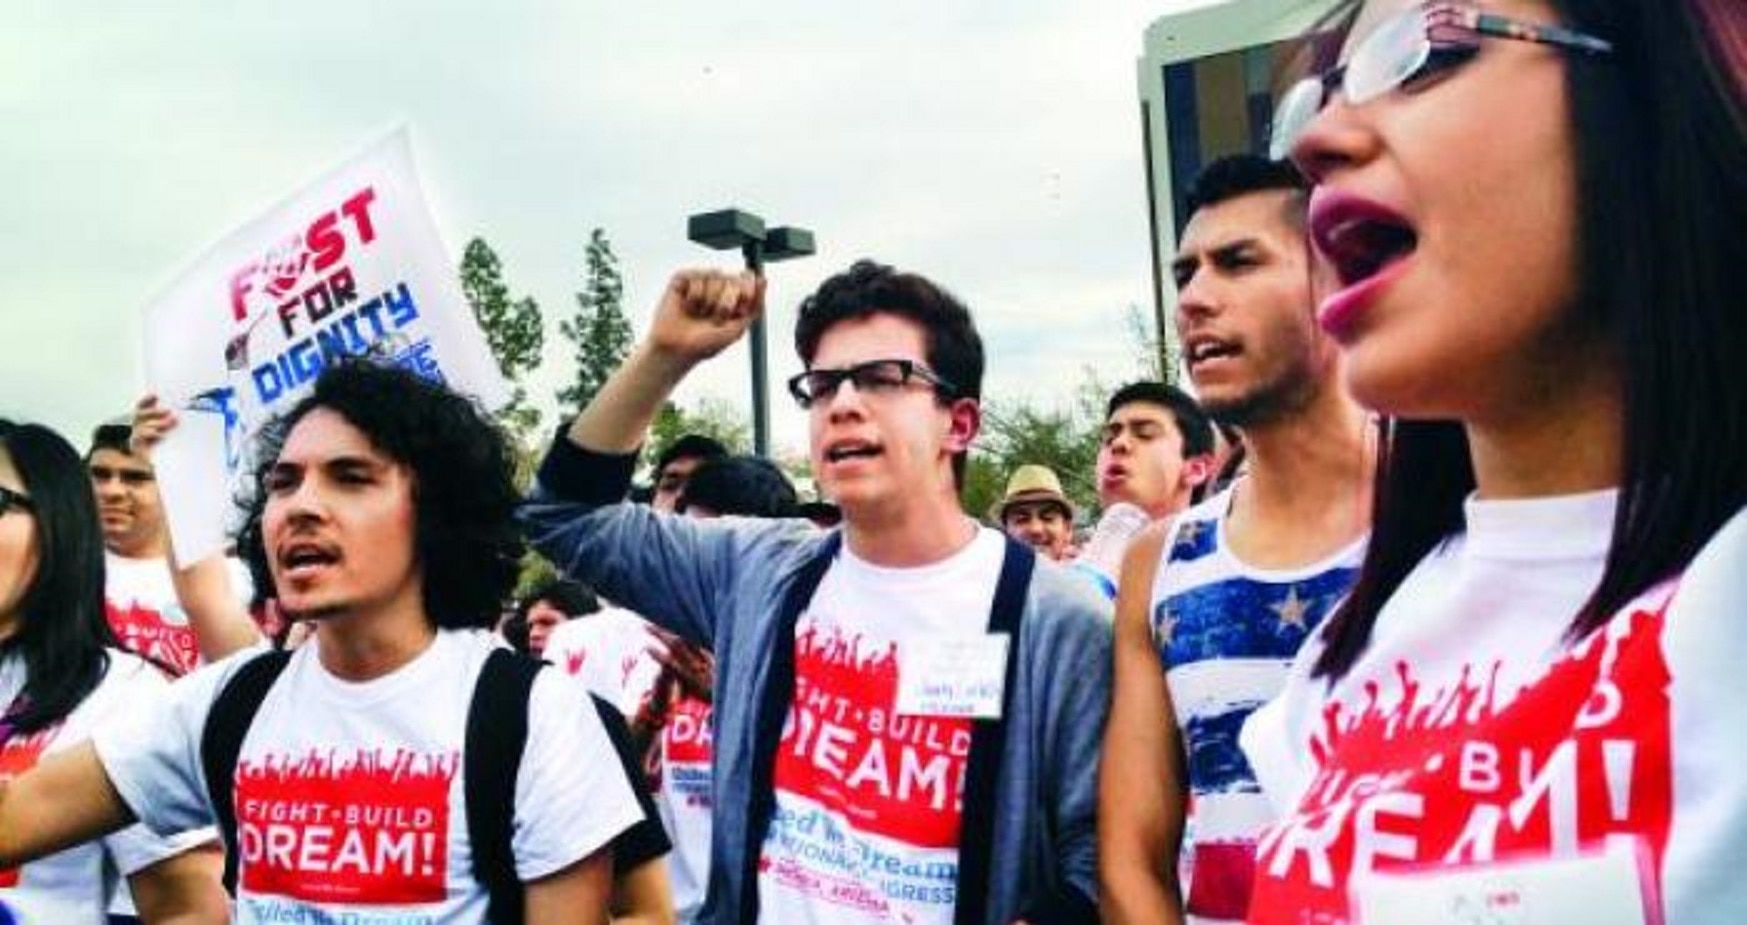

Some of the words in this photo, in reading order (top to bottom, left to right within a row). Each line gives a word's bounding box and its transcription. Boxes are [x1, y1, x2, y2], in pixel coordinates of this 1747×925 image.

[228, 186, 376, 321] FST
[277, 265, 358, 339] FOR
[252, 283, 419, 403] DIGNITY
[868, 708, 971, 755] BUILD
[345, 804, 433, 828] BUILD
[242, 823, 435, 875] DREAM!
